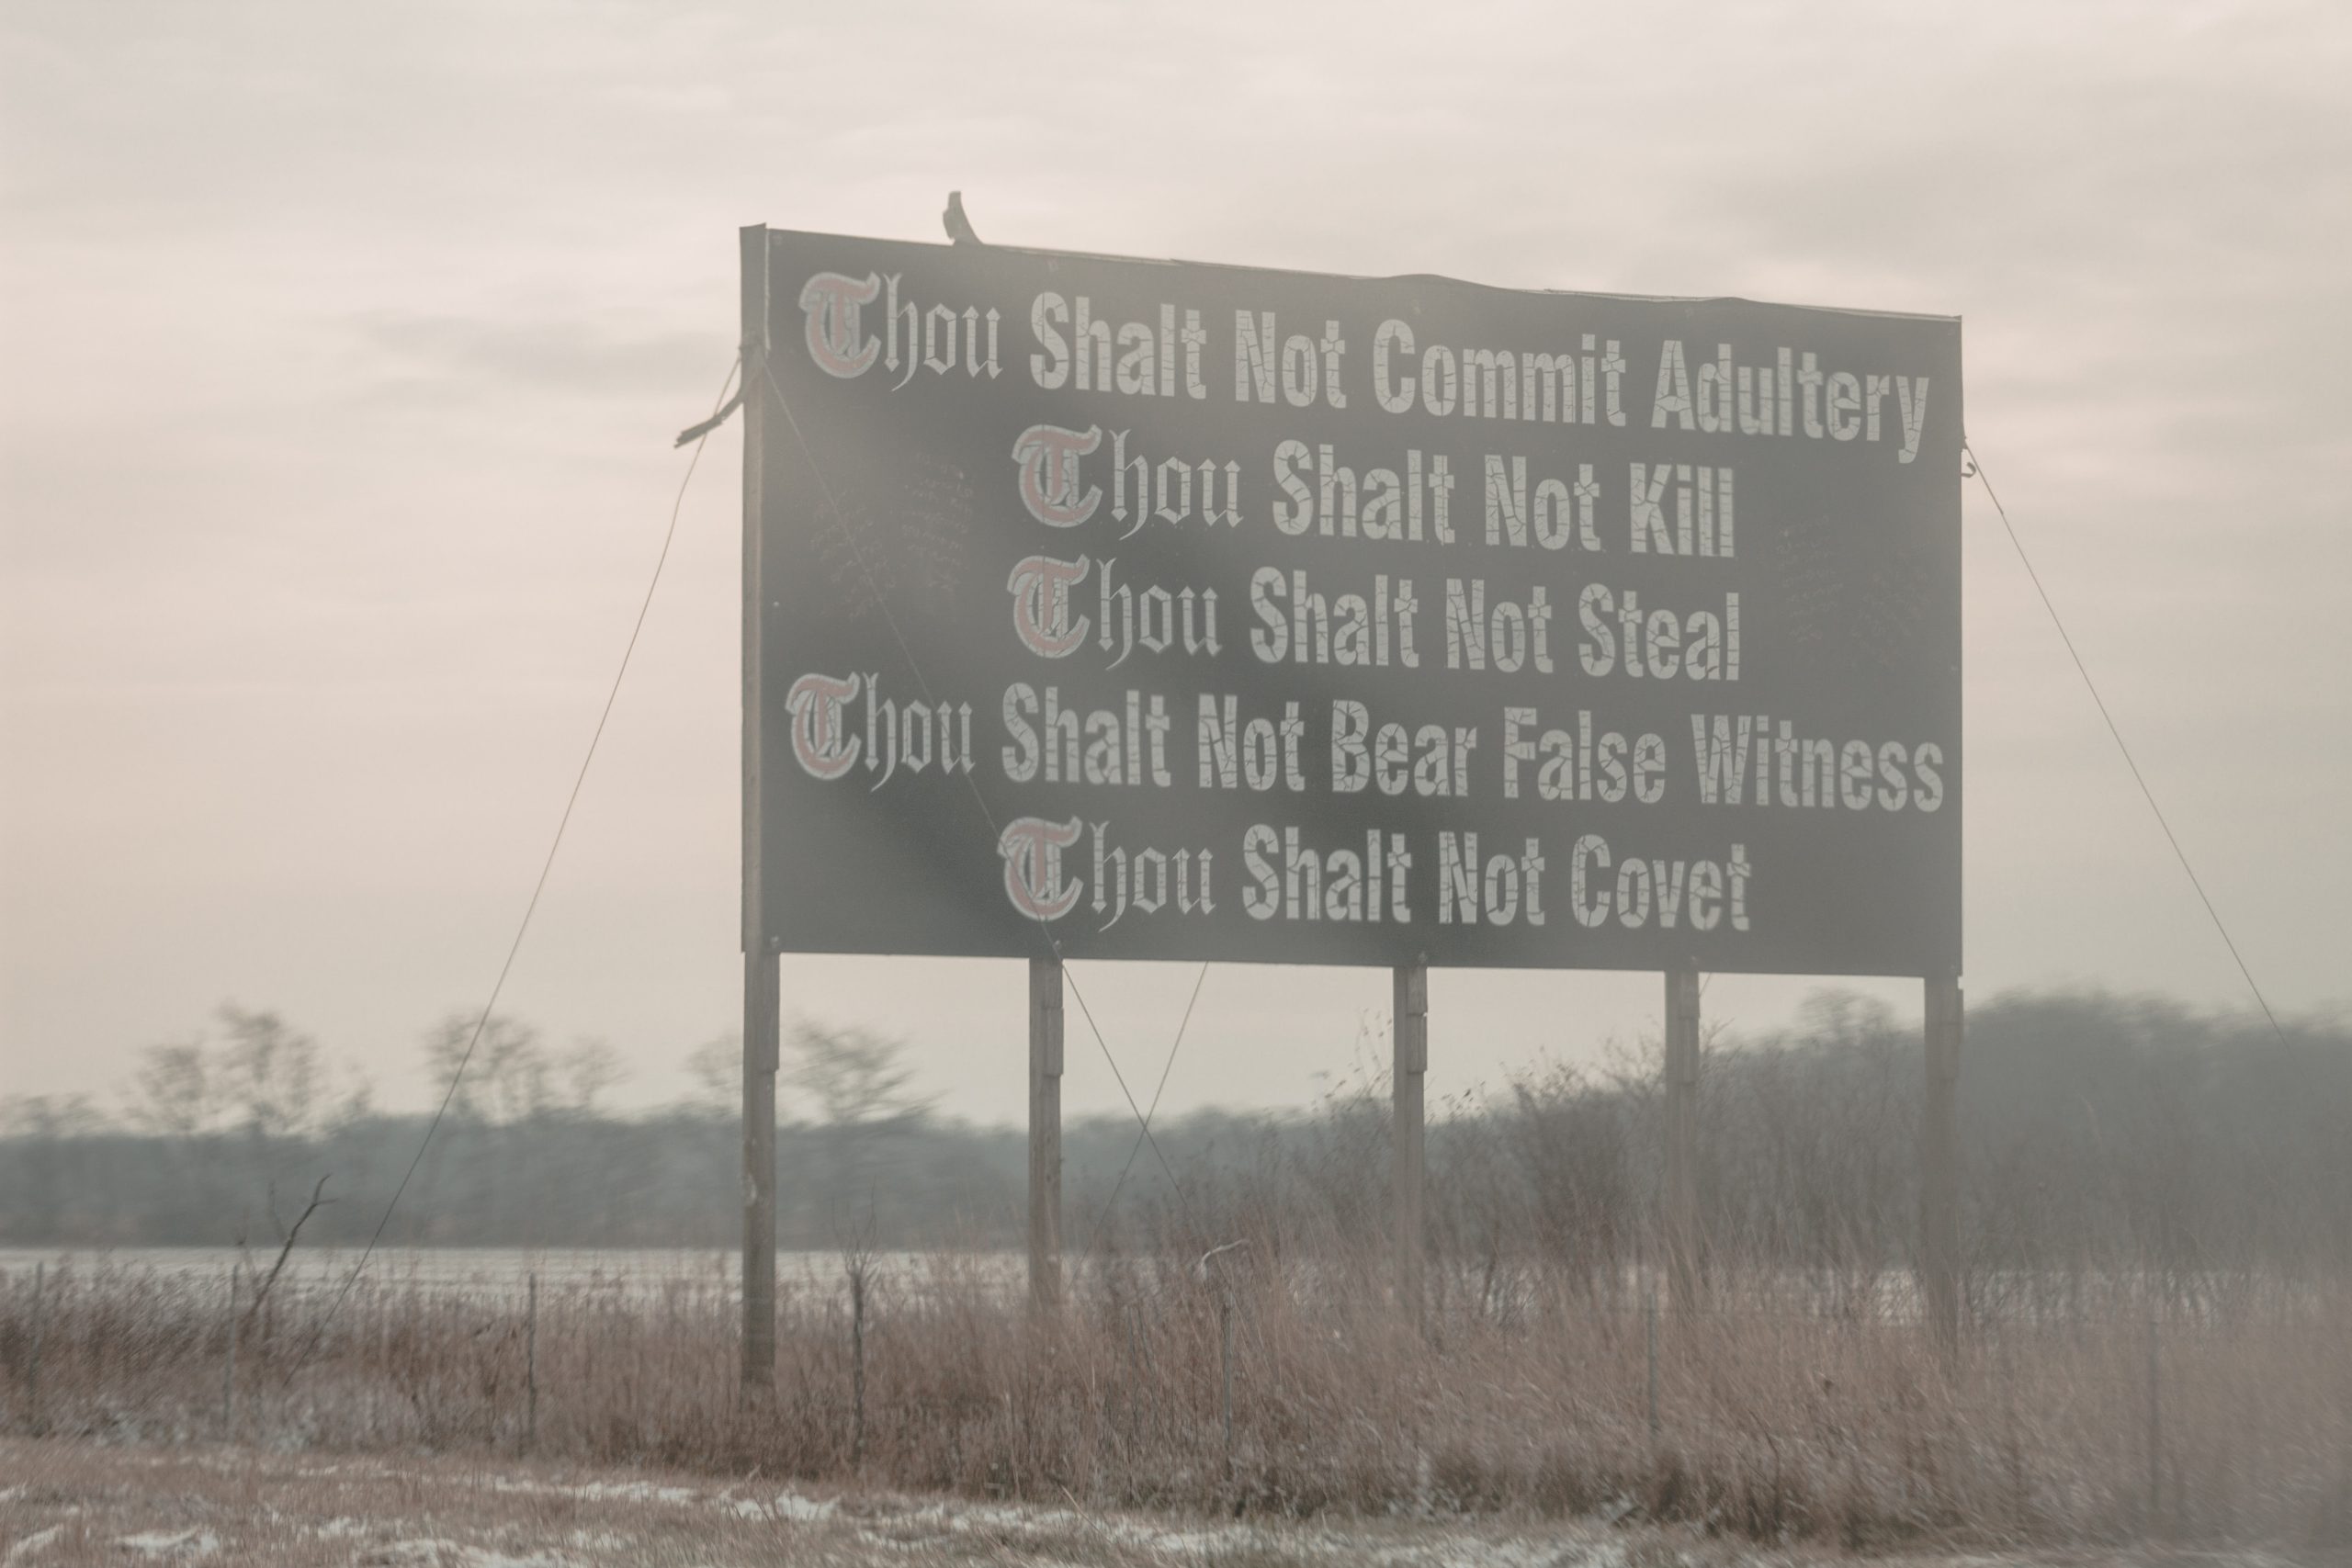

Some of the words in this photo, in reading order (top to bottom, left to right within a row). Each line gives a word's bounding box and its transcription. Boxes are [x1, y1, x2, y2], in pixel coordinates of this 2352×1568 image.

[797, 271, 1002, 391] Thou
[1029, 292, 1206, 400] Shalt
[1236, 310, 1346, 408] Not
[1374, 319, 1625, 426] Commit
[1651, 340, 1928, 463] Adultery
[1011, 423, 1244, 540] Thou
[1271, 438, 1456, 546] Shalt
[1485, 455, 1600, 550] Not
[1630, 463, 1734, 558] Kill
[1005, 553, 1224, 671] Thou
[1250, 566, 1419, 671] Shalt
[1447, 579, 1554, 673] Not
[1578, 583, 1739, 681] Steal
[785, 671, 976, 791] Thou
[1001, 682, 1171, 787] Shalt
[1198, 694, 1306, 791] Not
[1330, 699, 1477, 799] Bear
[1503, 707, 1665, 804] False
[1691, 715, 1943, 811] Witness
[997, 817, 1216, 932] Thou
[1240, 823, 1415, 925] Shalt
[1439, 831, 1545, 924] Not
[1571, 834, 1750, 931] Covet
